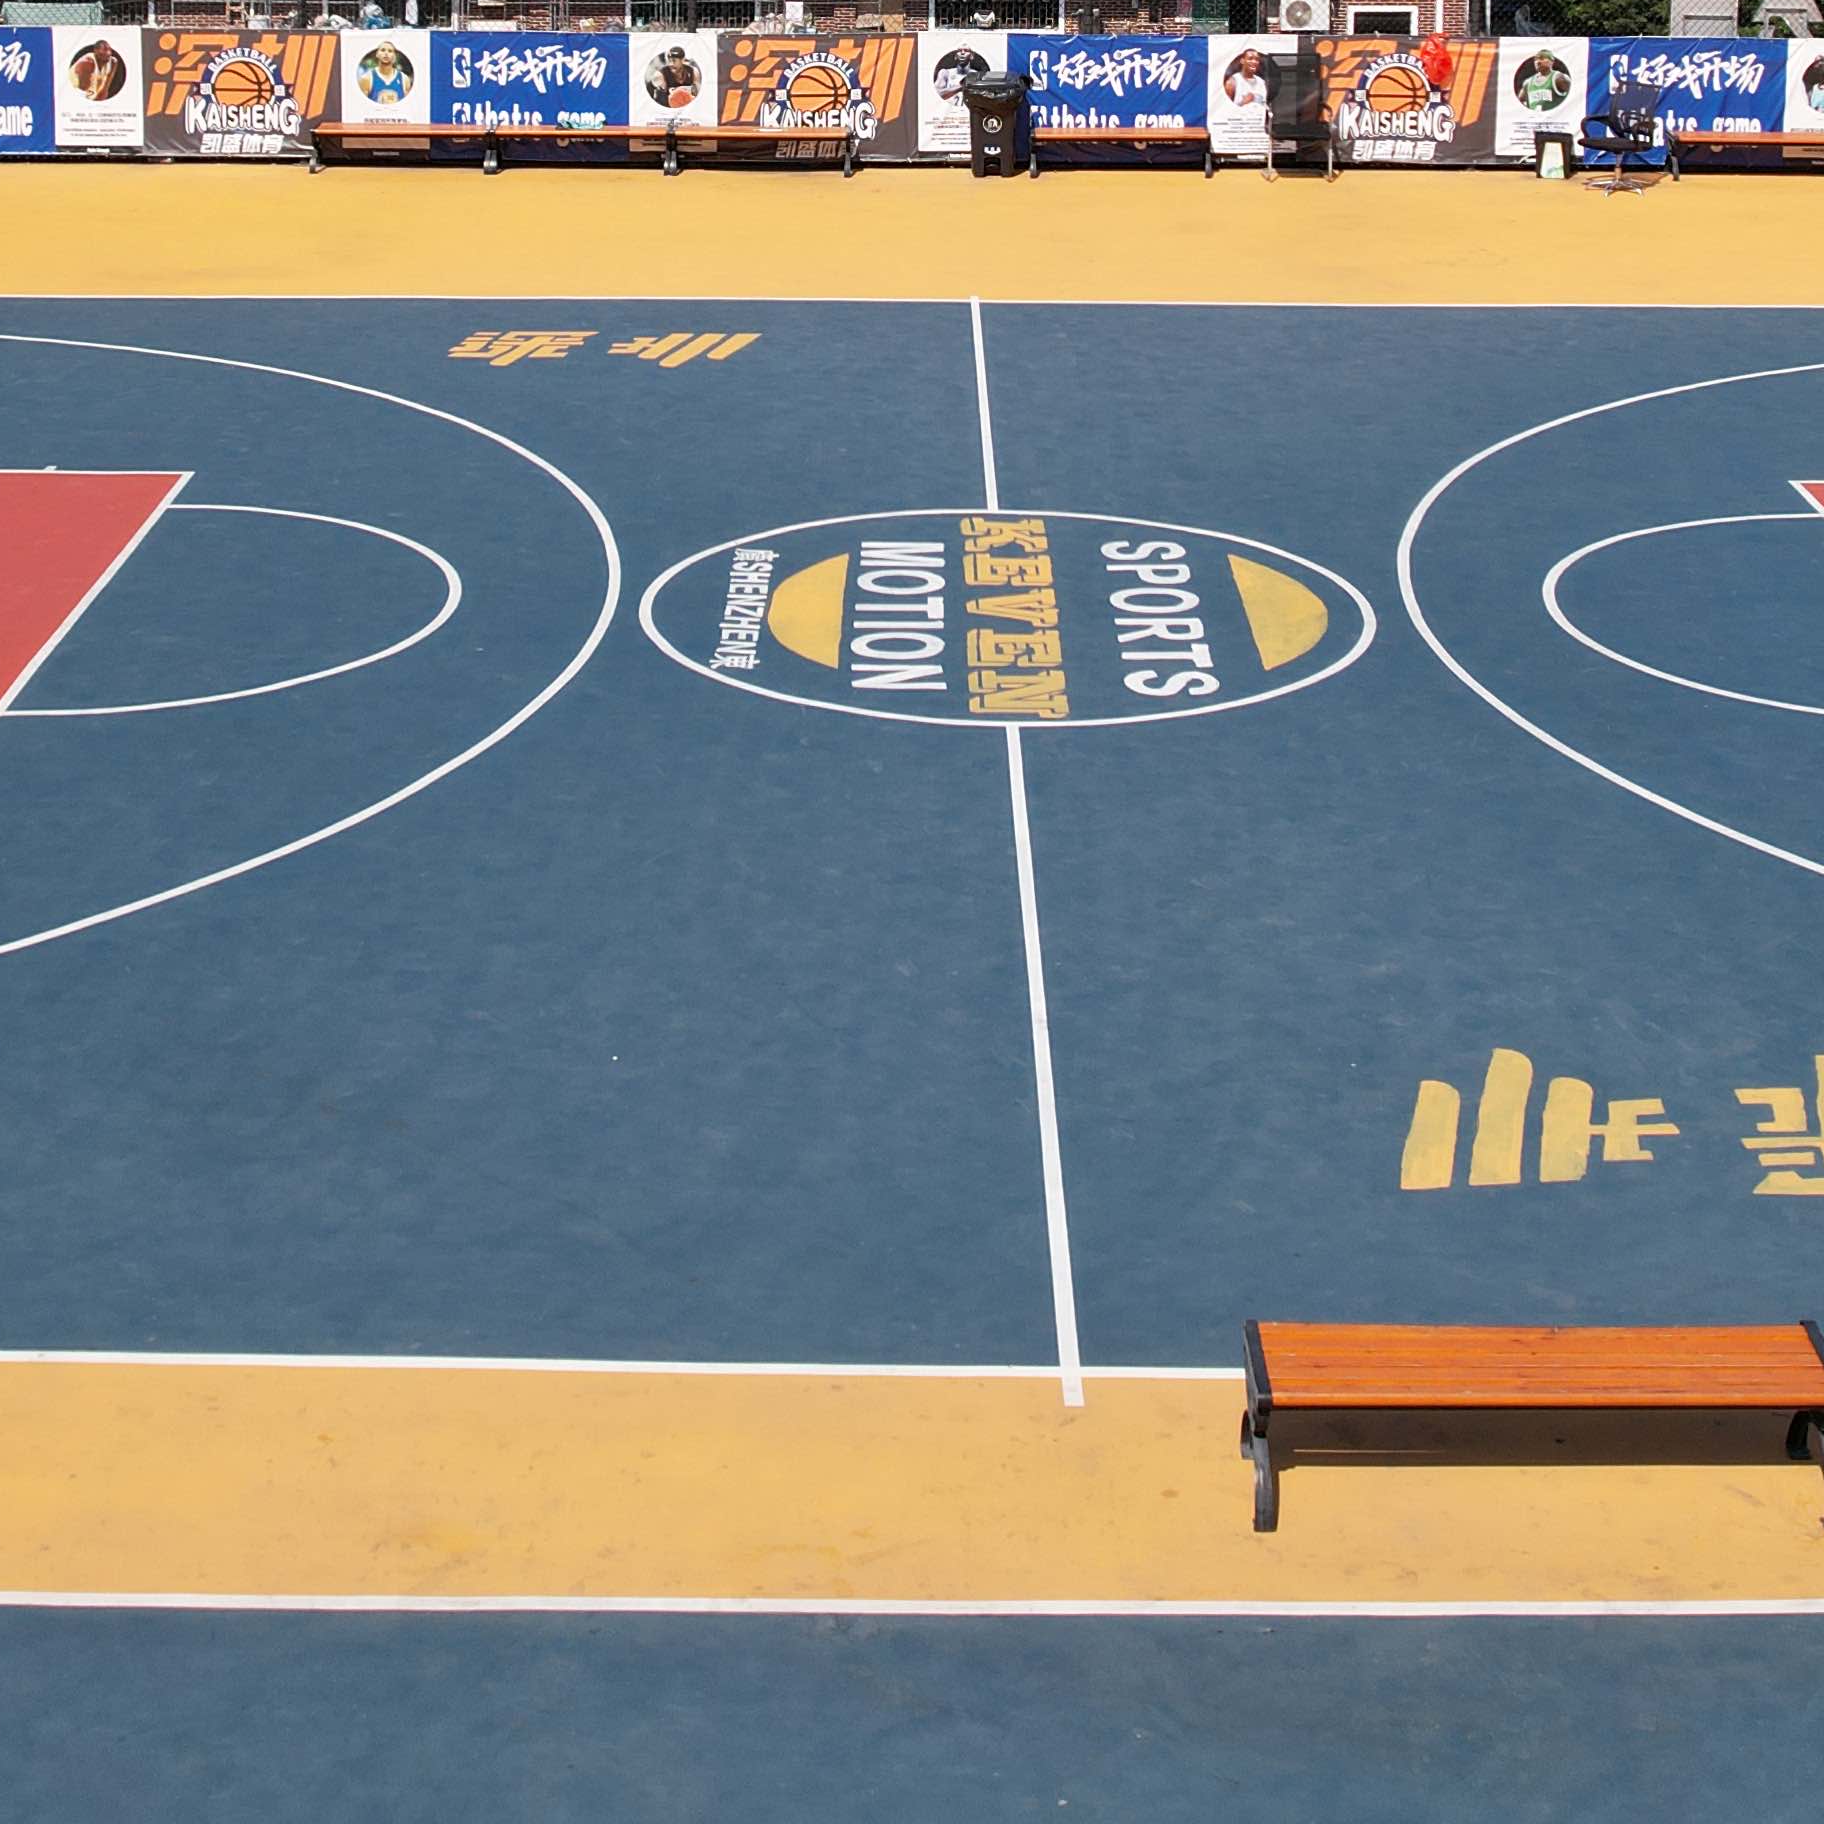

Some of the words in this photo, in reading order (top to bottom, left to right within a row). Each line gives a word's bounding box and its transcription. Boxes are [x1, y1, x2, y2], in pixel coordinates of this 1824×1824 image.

[207, 47, 277, 74] BASKETBALL
[783, 52, 855, 78] BASKETBALL
[1364, 53, 1425, 77] BASKETBA
[184, 95, 302, 137] KAISHENG
[1339, 102, 1456, 143] KAISHENG
[199, 133, 285, 154] 凯盛体育
[1351, 139, 1438, 161] 凯盛体育
[849, 539, 947, 691] MOTION
[959, 516, 1070, 720] KEVEN
[1099, 539, 1221, 698] SPORTS
